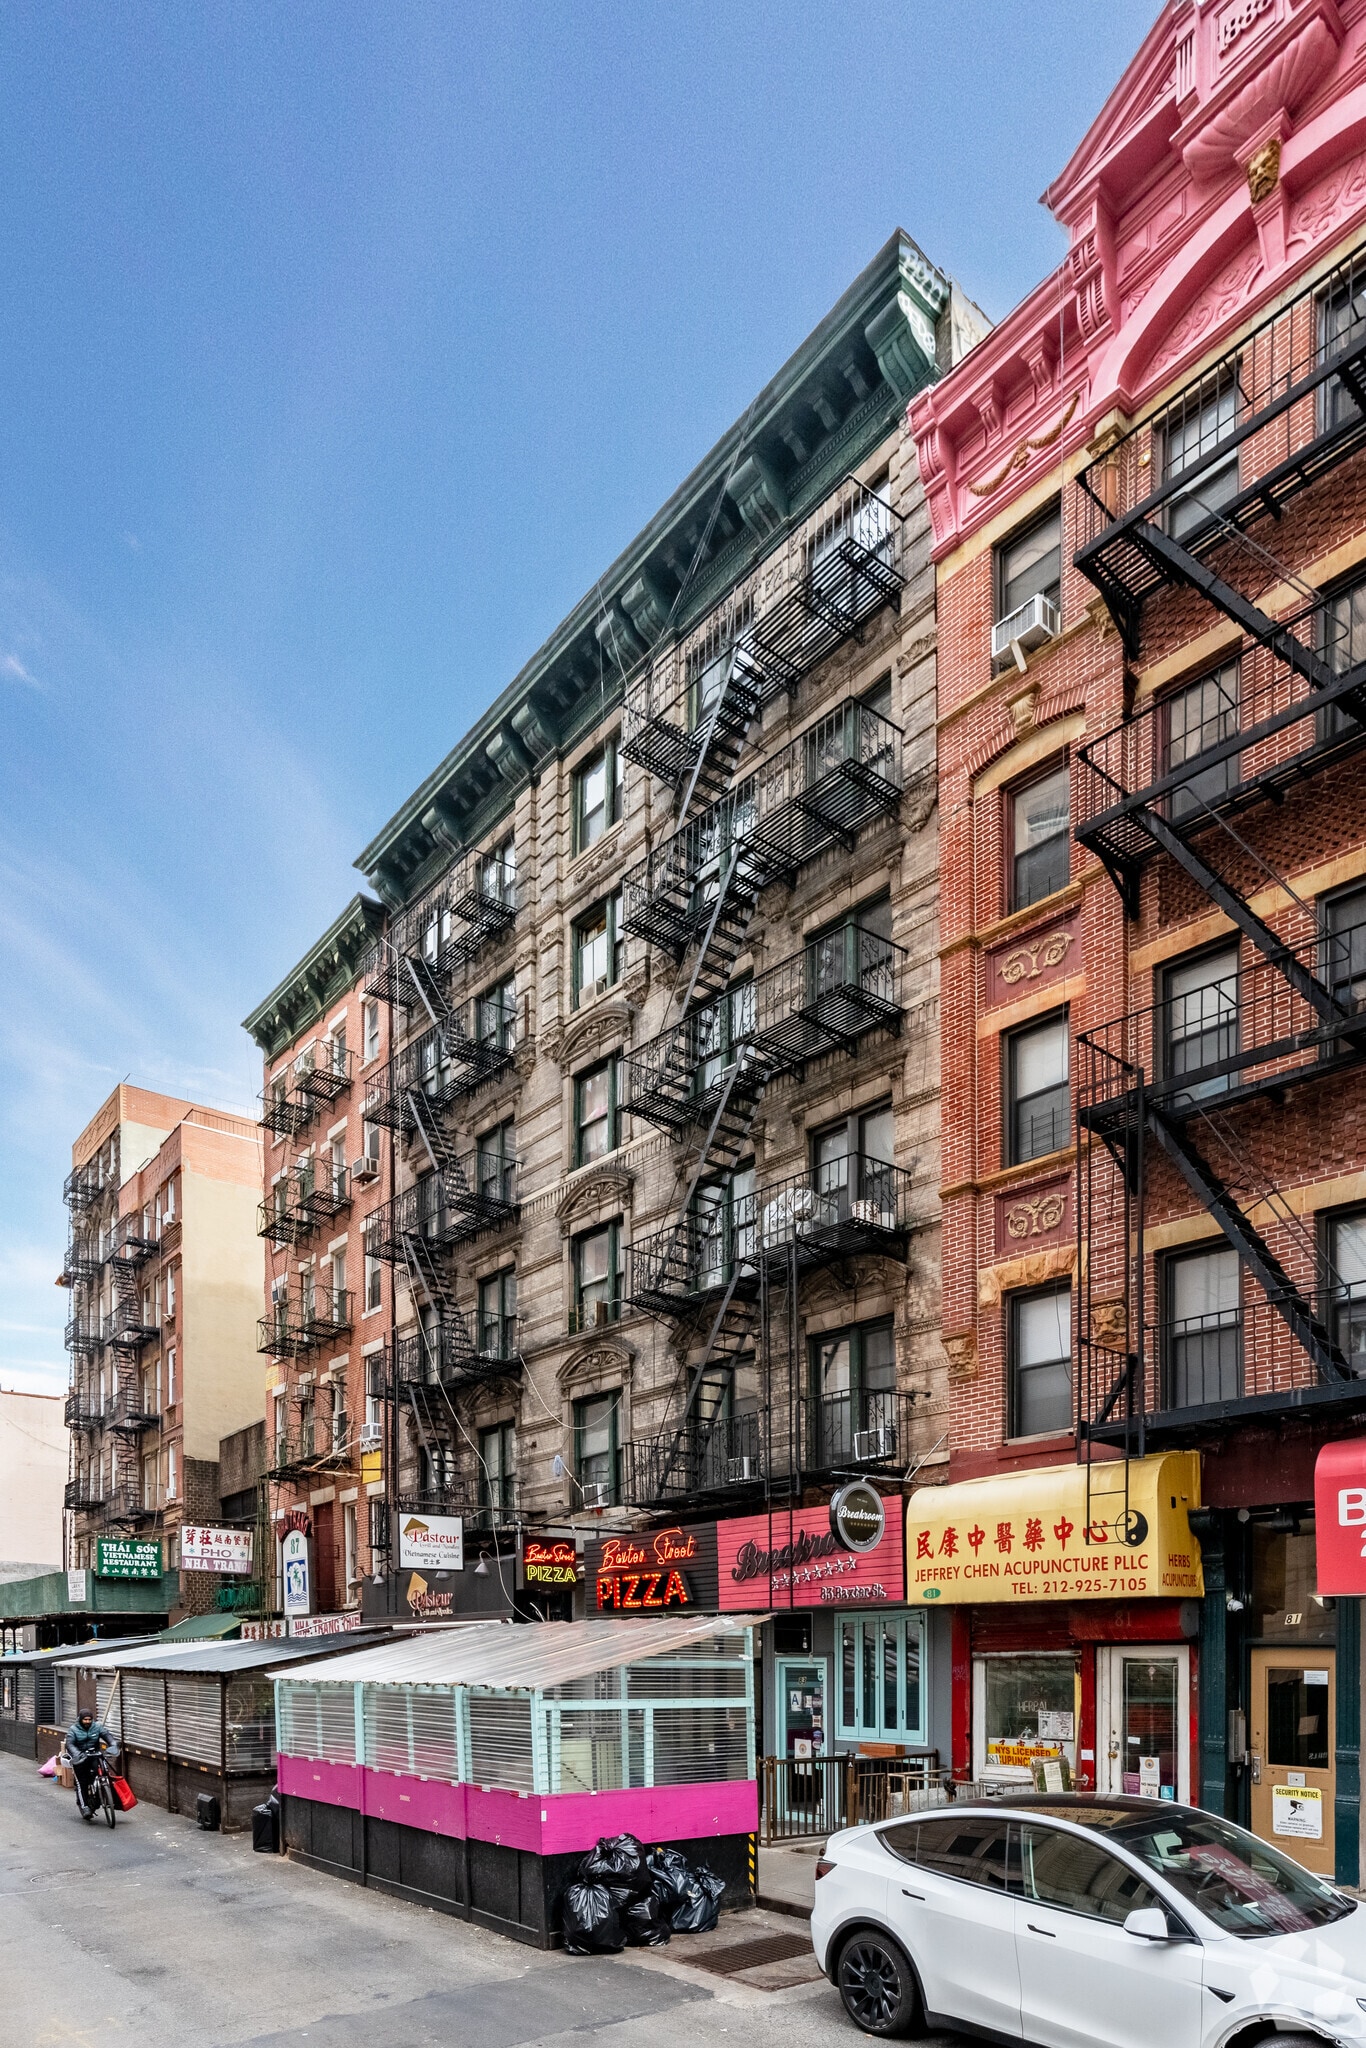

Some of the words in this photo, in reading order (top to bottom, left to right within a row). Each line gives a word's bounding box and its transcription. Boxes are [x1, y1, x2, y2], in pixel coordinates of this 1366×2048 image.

[837, 1505, 884, 1521] Breakroom
[409, 1530, 460, 1544] Pasteur
[916, 1515, 1109, 1559] 民康中醫藥中心
[101, 1541, 131, 1553] THÁI
[290, 1538, 299, 1554] 87
[553, 1544, 575, 1562] Street
[653, 1529, 695, 1564] Street
[103, 1552, 155, 1560] VIETNAMESE
[439, 1551, 460, 1559] Cuisine
[732, 1529, 837, 1581] Breakro
[1168, 1553, 1191, 1568] HERBS
[103, 1559, 157, 1567] RESTAURANT
[185, 1558, 209, 1569] NHA
[213, 1560, 248, 1572] TRANG
[915, 1566, 960, 1583] JEFFREY
[963, 1563, 1000, 1578] CHEN
[1003, 1556, 1109, 1576] ACUPUNCTURE
[1114, 1554, 1149, 1570] PLLC
[527, 1565, 576, 1582] PIZZA
[1162, 1573, 1198, 1587] ACUPUNCTURE
[597, 1570, 689, 1609] PIZZA
[821, 1586, 834, 1600] 83
[835, 1585, 871, 1600] Baxter
[1011, 1581, 1038, 1594] TEL:
[1042, 1577, 1147, 1594] 212-925-7105
[926, 1589, 937, 1598] 81
[1286, 1614, 1299, 1624] 81
[791, 1693, 800, 1706] A
[995, 1746, 1011, 1755] NYS
[1012, 1748, 1051, 1757] LICENSED
[1276, 1788, 1299, 1797] SECURITY
[1301, 1791, 1319, 1799] NOTICE
